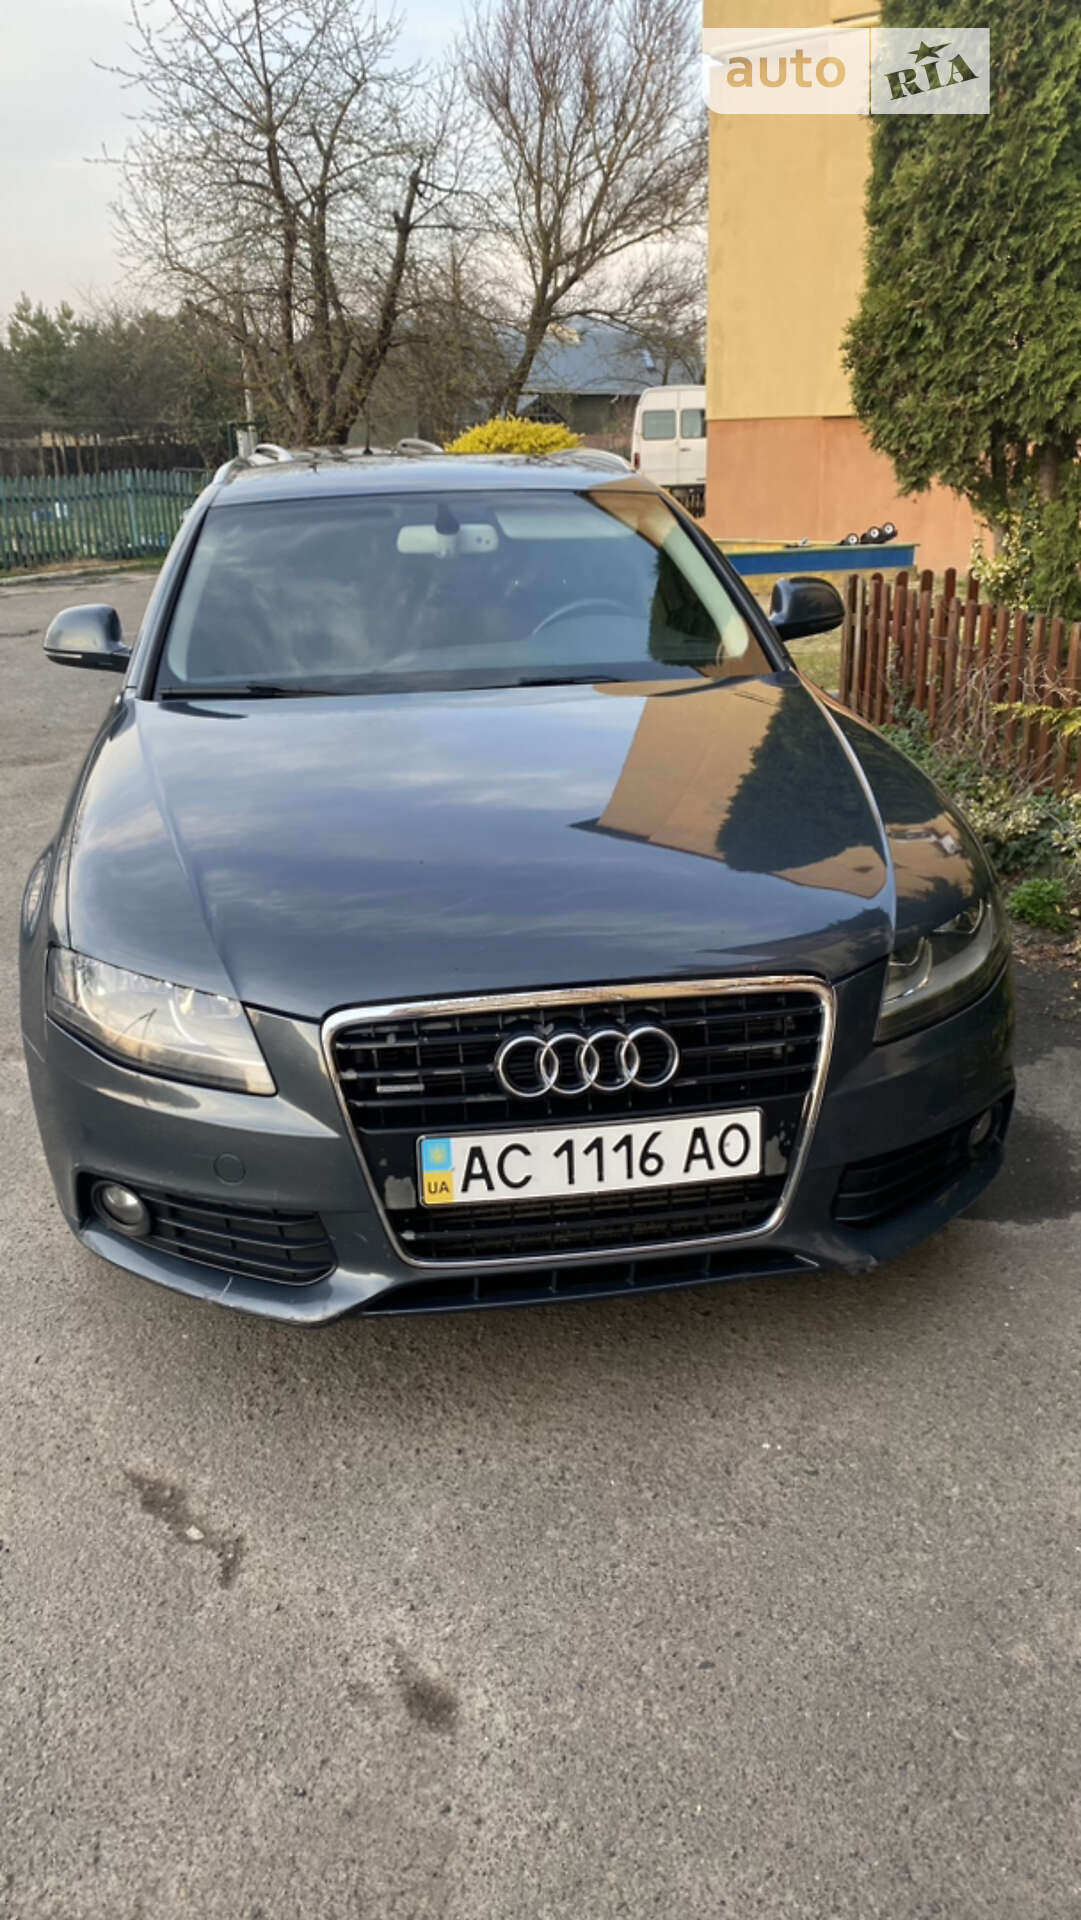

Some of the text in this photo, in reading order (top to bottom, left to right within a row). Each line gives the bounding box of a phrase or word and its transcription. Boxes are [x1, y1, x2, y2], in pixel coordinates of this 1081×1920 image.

[460, 1122, 751, 1193] AC 1116 AO
[427, 1179, 450, 1195] UA
